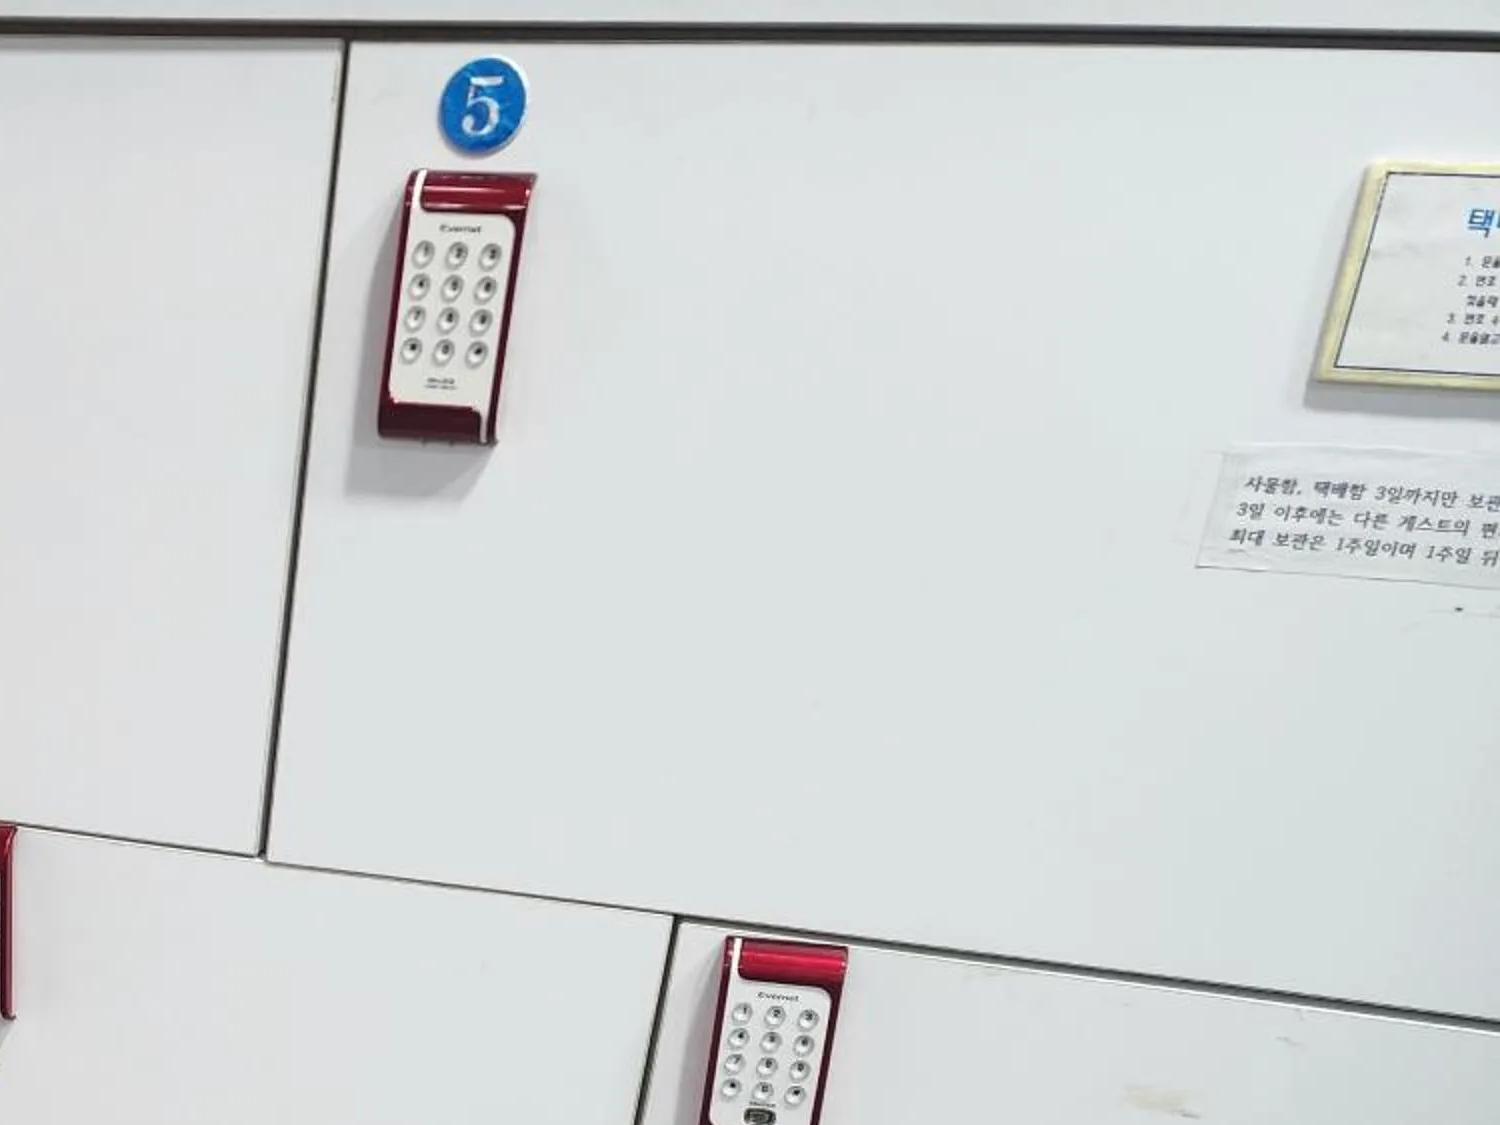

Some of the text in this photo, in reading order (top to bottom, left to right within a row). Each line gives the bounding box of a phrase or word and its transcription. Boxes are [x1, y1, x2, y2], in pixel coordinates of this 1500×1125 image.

[461, 76, 505, 137] 5
[1467, 208, 1500, 238] 택
[1313, 479, 1367, 501] 택배함
[1373, 484, 1459, 509] 3일까지만
[1235, 501, 1265, 521] 3일
[1273, 503, 1344, 527] 이후에는
[1353, 510, 1389, 531] 다른
[1399, 514, 1471, 537] 게스트의
[1228, 527, 1265, 547] 최대
[1272, 531, 1328, 552] 보관은
[1335, 536, 1417, 560] 1주일이며
[1425, 545, 1473, 565] 1주일
[757, 990, 800, 1002] Evernet
